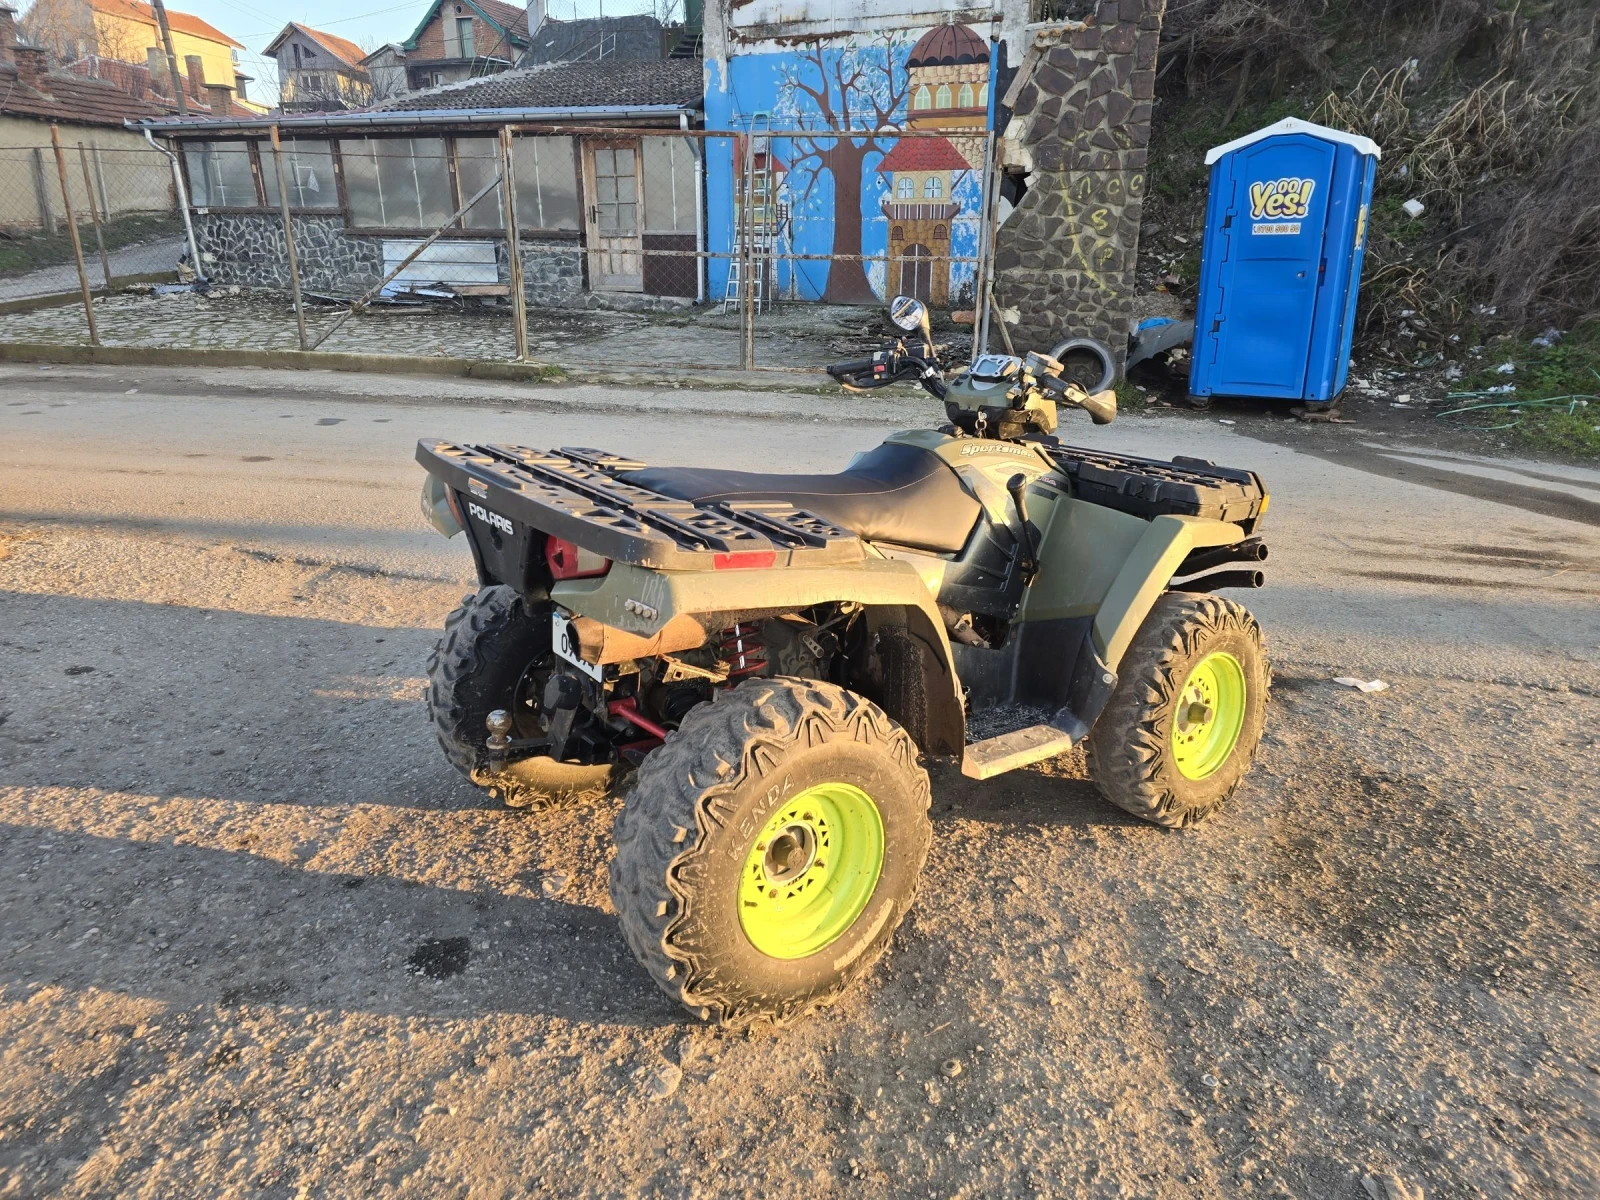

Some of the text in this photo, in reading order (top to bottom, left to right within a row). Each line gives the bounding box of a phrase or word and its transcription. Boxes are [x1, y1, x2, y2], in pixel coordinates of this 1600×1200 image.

[1251, 180, 1314, 217] Yes!
[468, 502, 514, 535] POLARIS
[727, 773, 795, 860] KENDA
